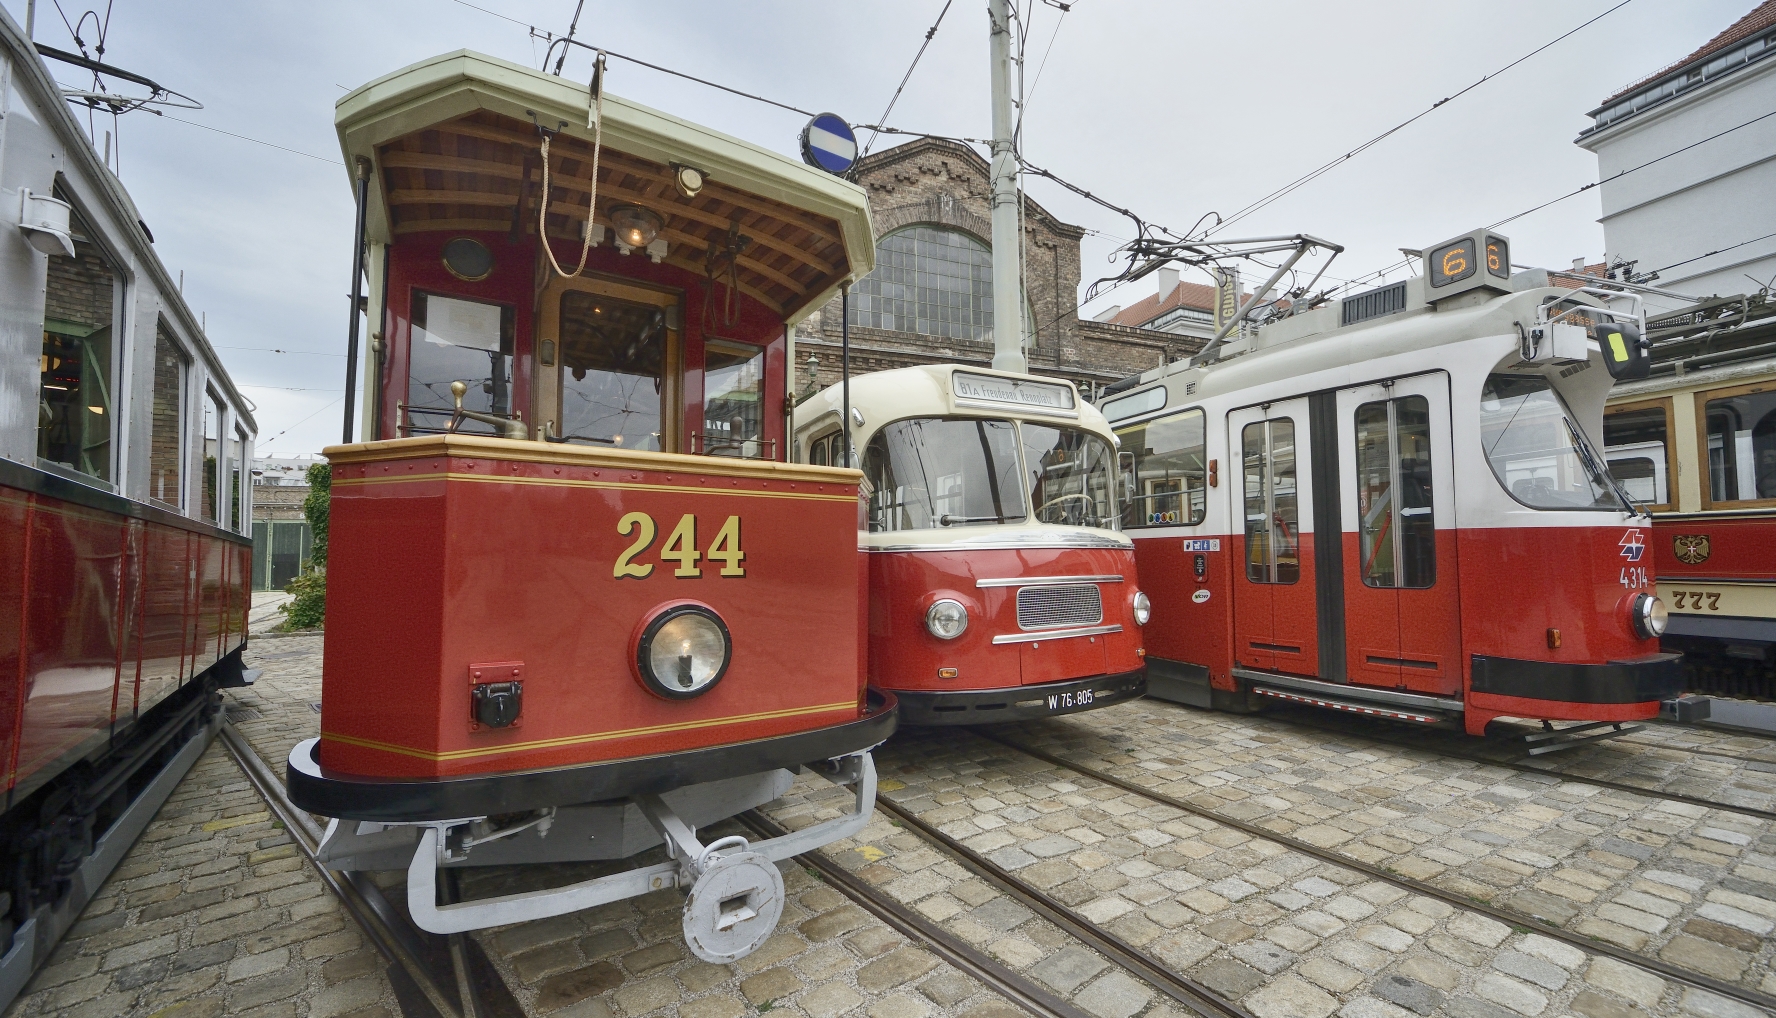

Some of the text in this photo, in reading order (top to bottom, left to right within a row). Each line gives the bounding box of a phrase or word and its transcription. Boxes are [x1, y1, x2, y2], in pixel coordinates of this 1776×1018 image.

[1443, 248, 1466, 276] 6
[1487, 244, 1499, 270] 6
[1020, 389, 1053, 405] Rennplatz
[613, 511, 747, 580] 244
[1619, 567, 1648, 589] 4314
[1672, 590, 1721, 610] 777
[1048, 694, 1058, 710] W
